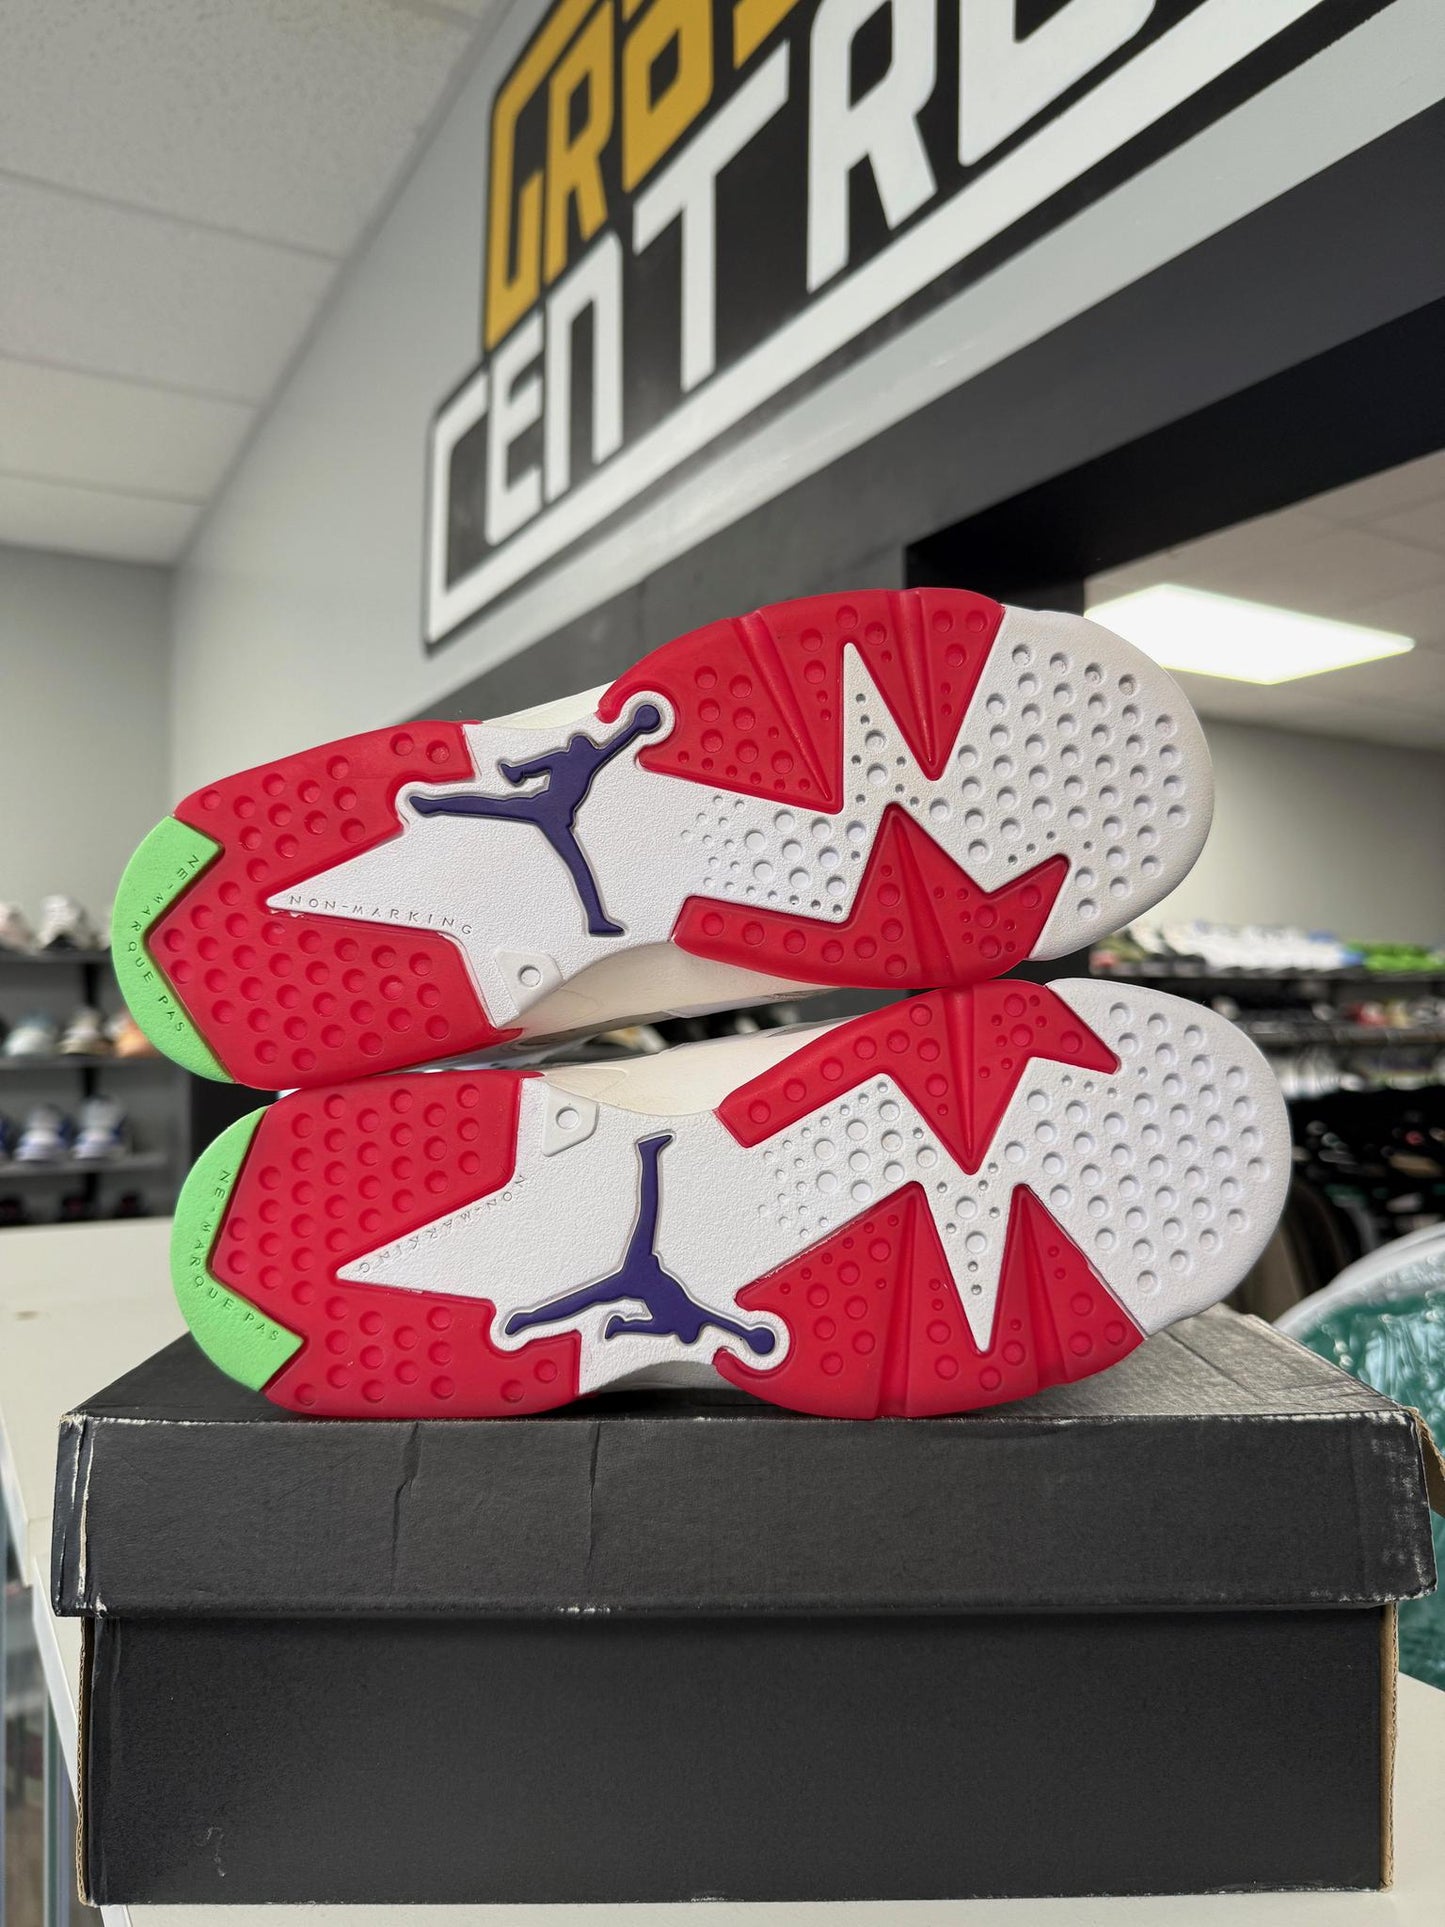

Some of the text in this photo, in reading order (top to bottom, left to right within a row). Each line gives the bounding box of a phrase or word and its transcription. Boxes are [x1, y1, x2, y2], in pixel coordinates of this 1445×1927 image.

[289, 894, 473, 936] NON-MARKING
[157, 995, 185, 1032] PAS
[244, 1312, 280, 1342] PAS
